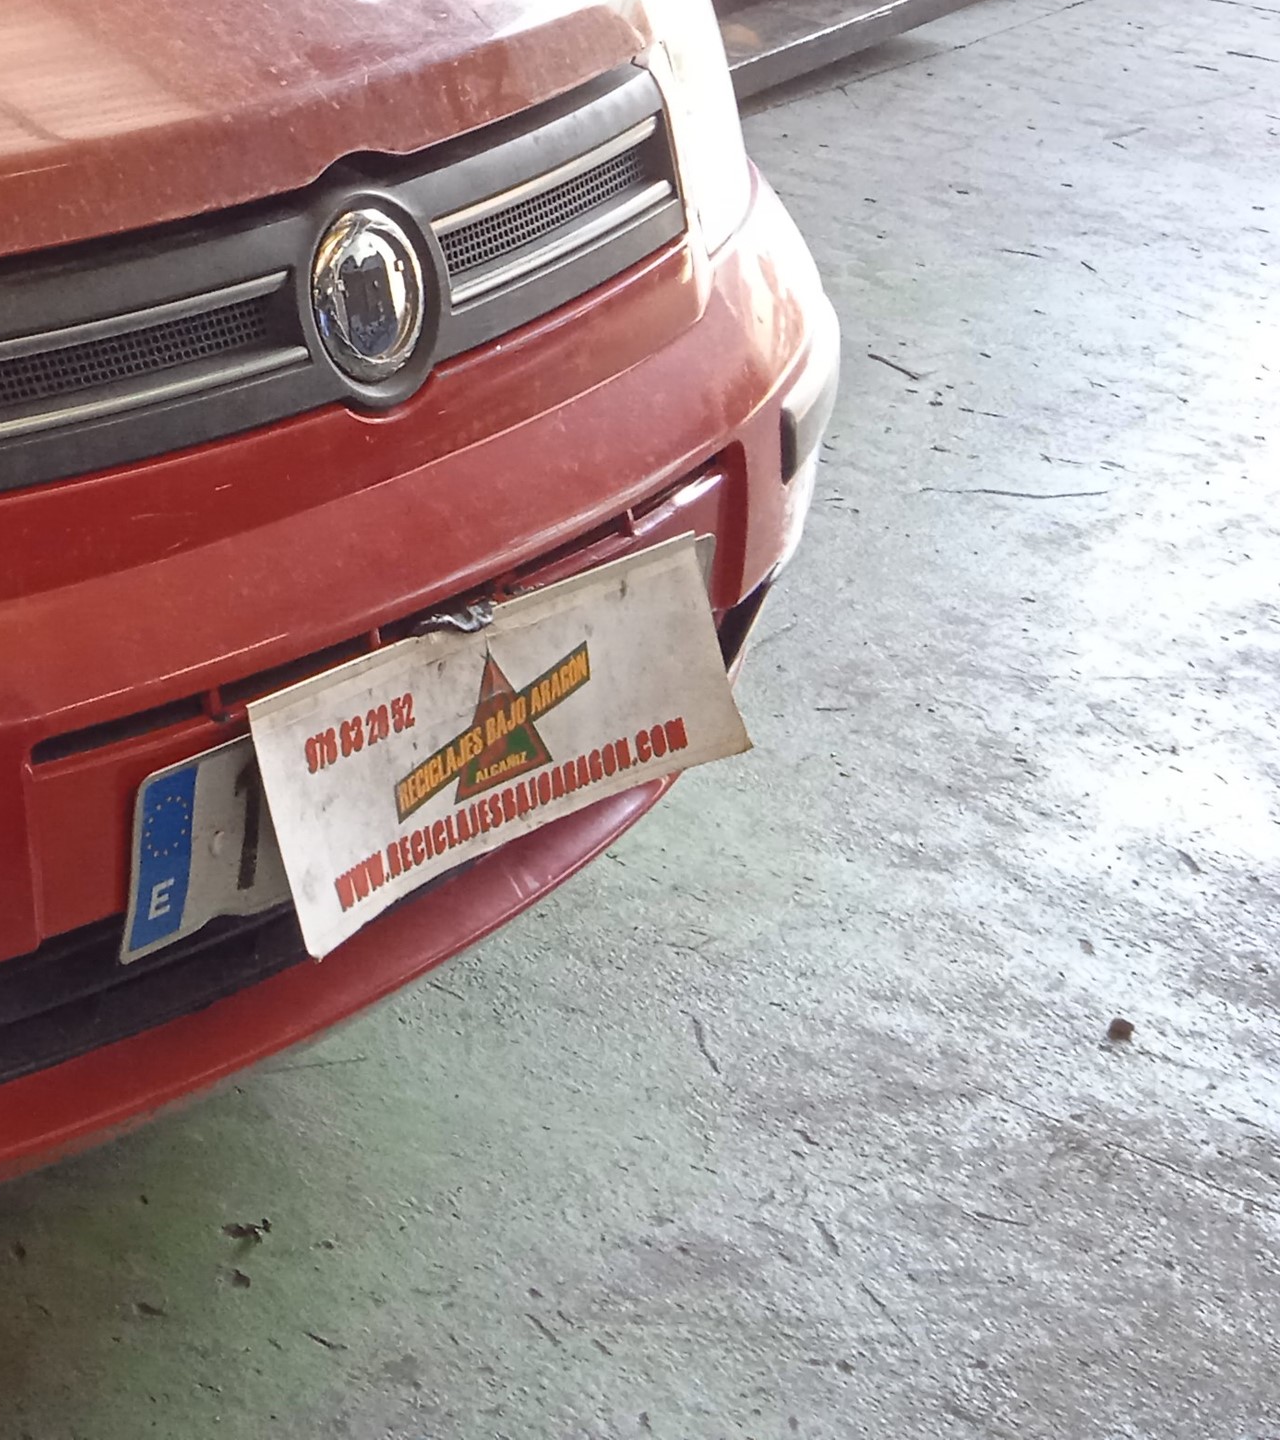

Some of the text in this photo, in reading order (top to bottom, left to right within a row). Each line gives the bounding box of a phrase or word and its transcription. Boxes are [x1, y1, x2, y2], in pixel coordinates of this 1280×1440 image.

[305, 727, 338, 774] 978
[340, 715, 364, 758] 83
[391, 692, 416, 733] 52
[397, 726, 484, 813] RECICLAJES
[484, 696, 527, 747] BAJO
[335, 716, 689, 913] WWW.RECICLAJESBAJOARAGON.COM
[148, 877, 175, 921] E
